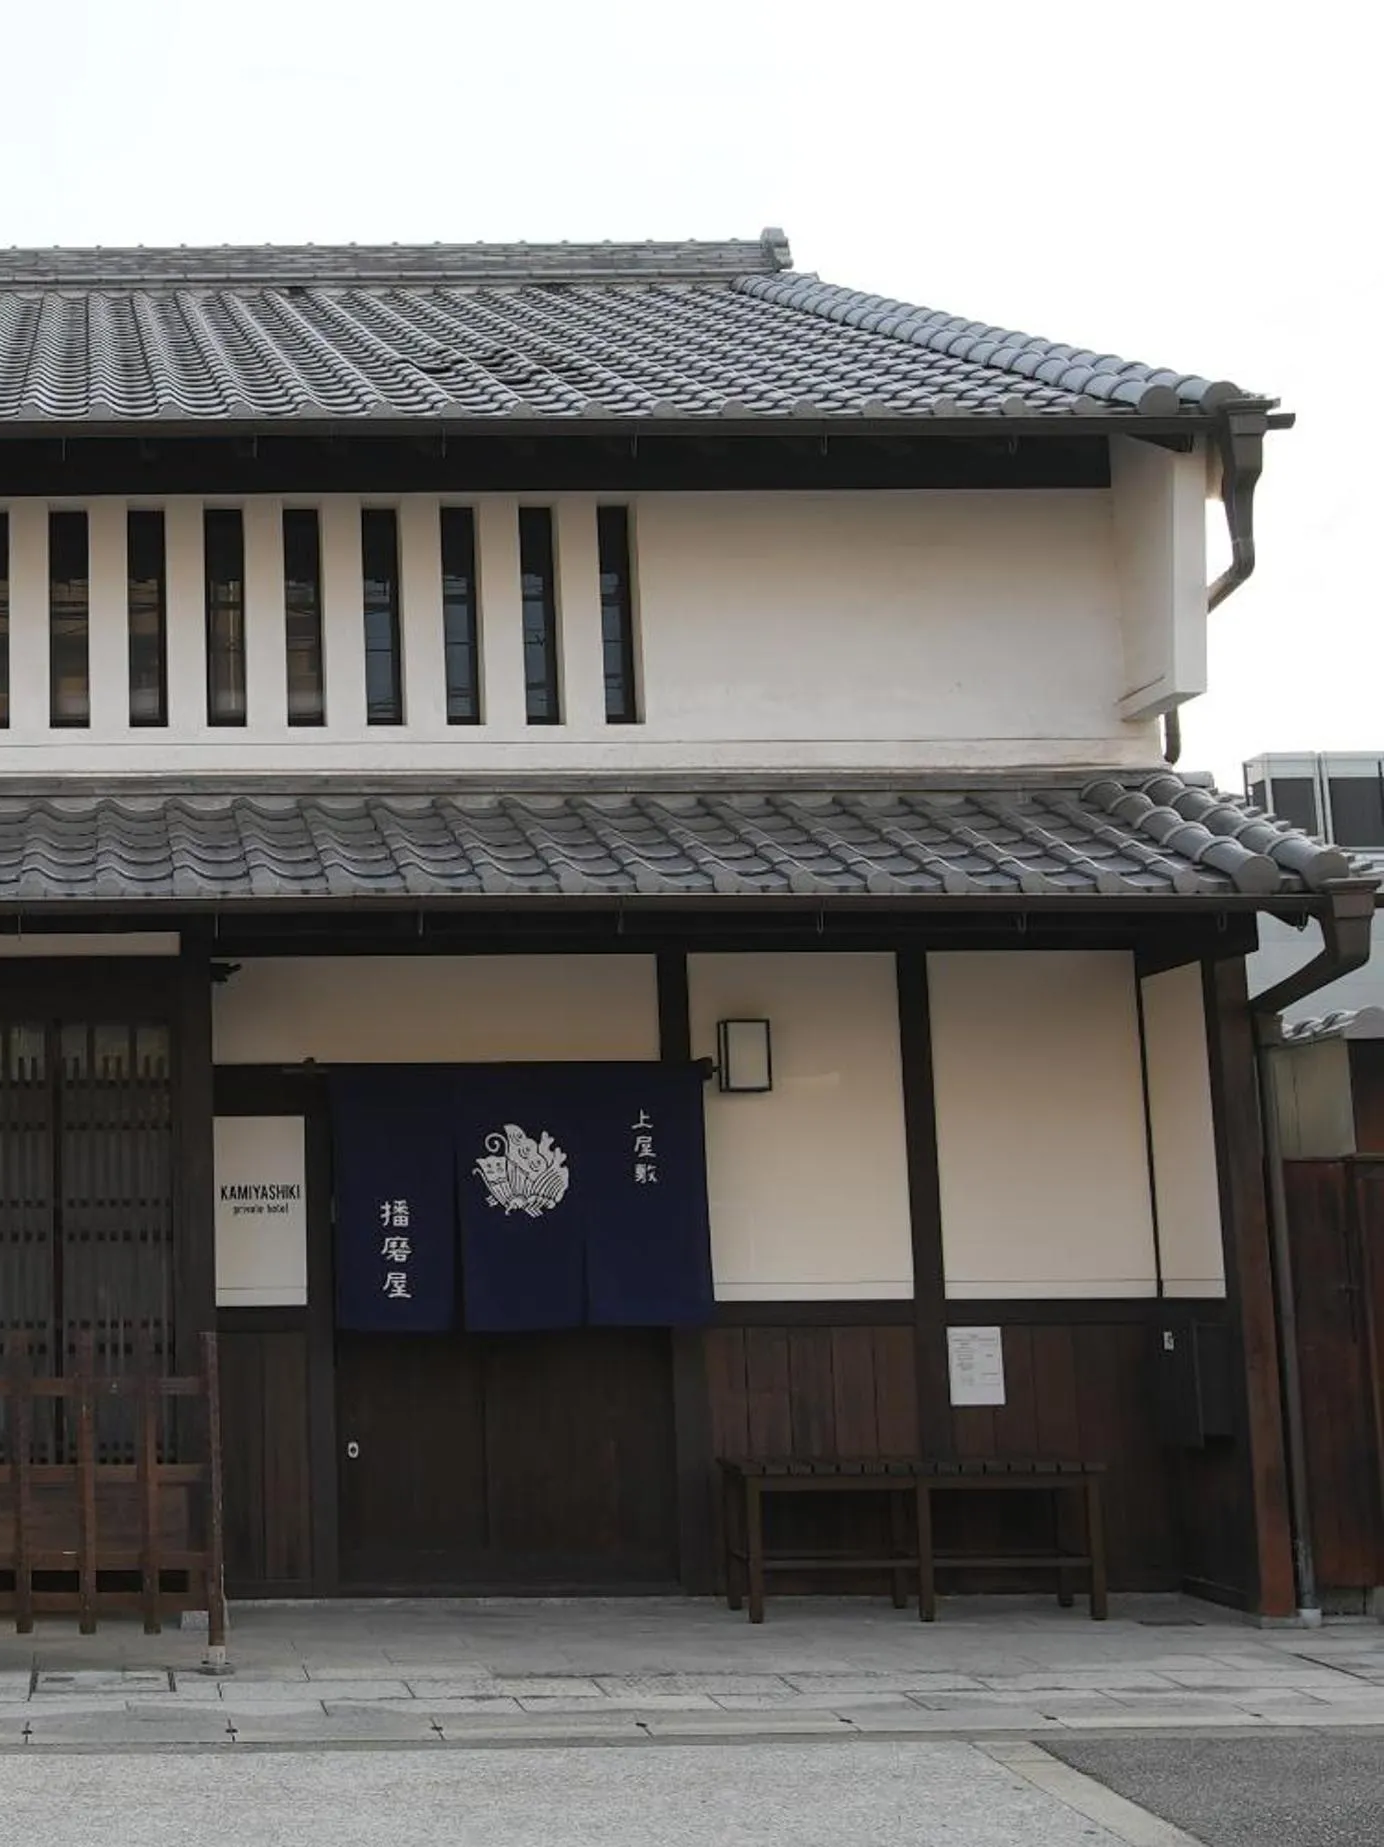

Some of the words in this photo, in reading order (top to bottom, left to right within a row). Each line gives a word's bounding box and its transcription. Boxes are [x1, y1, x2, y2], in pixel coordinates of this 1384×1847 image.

[631, 1108, 657, 1184] 上屋敷
[220, 1184, 300, 1200] KAMIYASHIKI
[267, 1202, 289, 1213] hotel
[380, 1199, 412, 1298] 播磨屋
